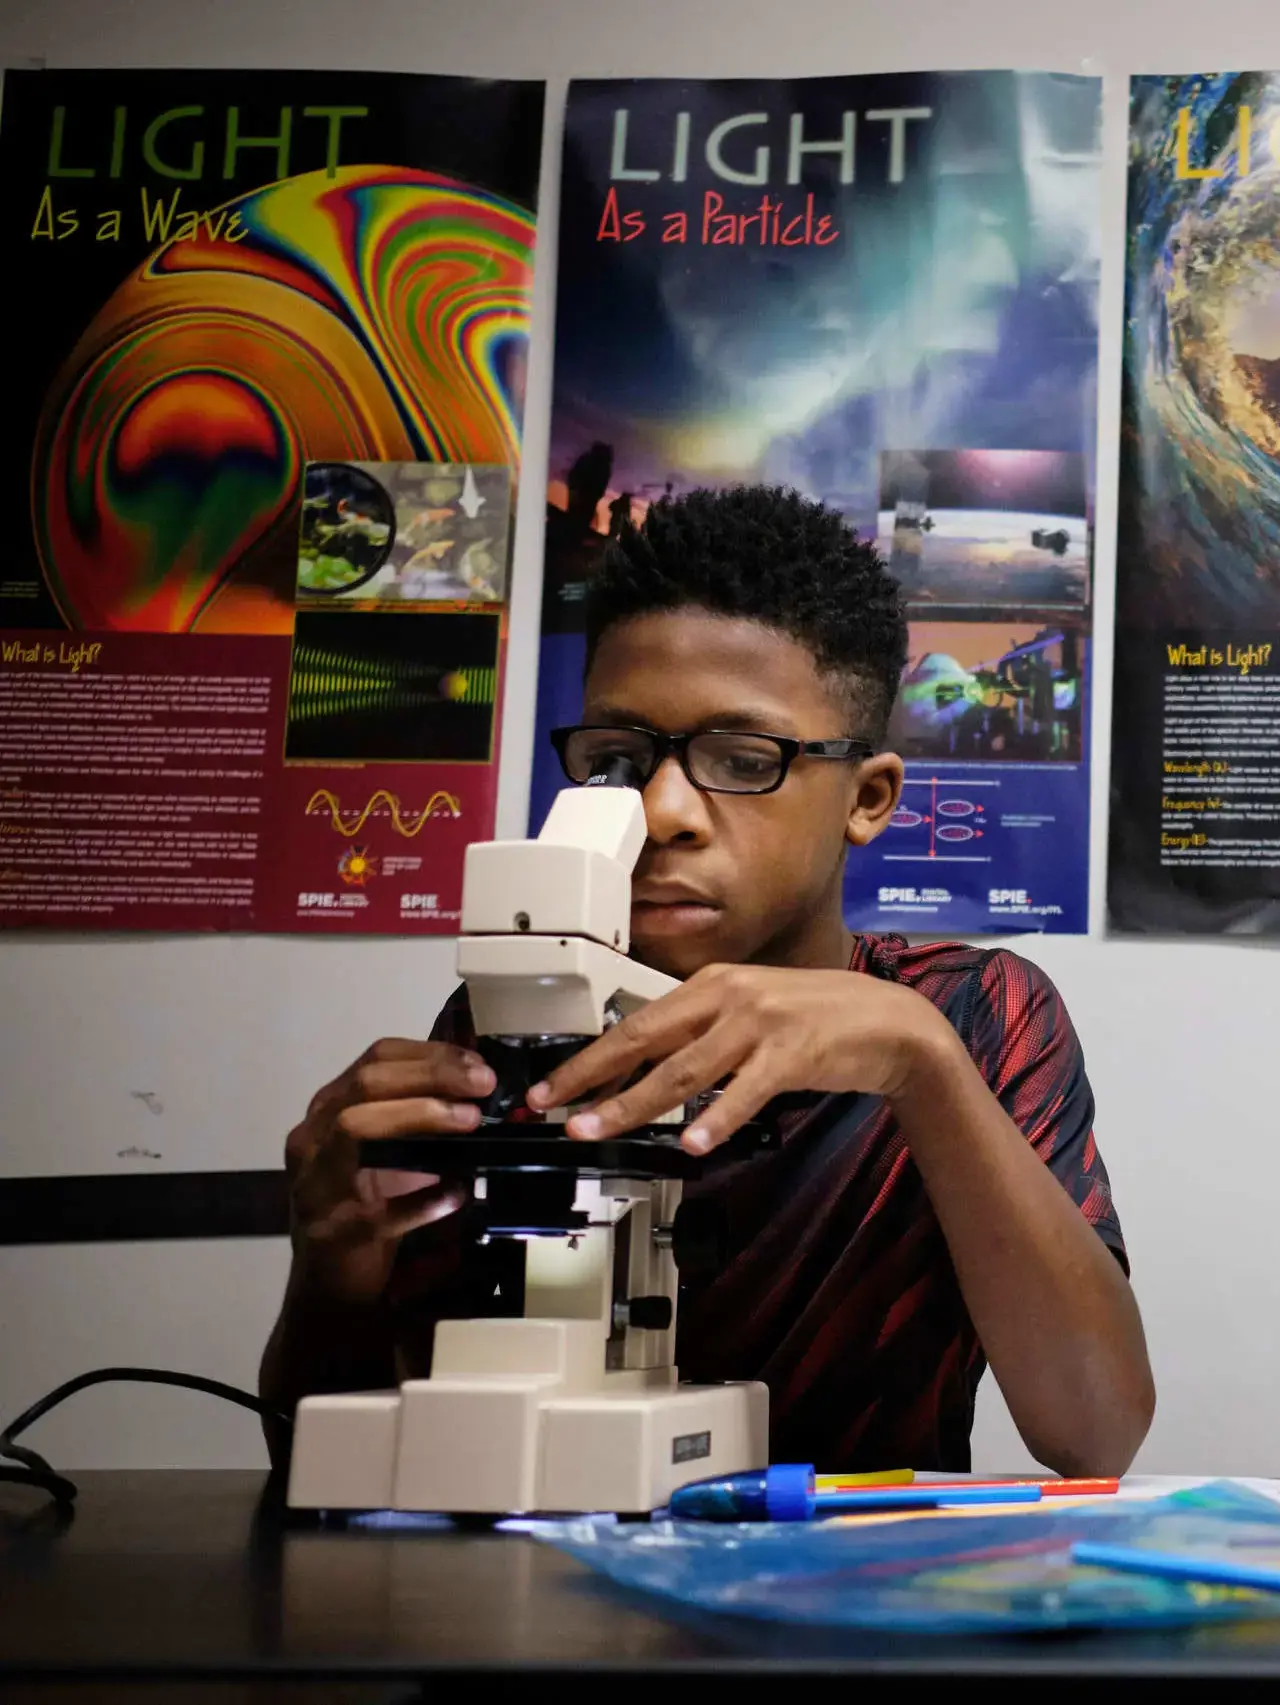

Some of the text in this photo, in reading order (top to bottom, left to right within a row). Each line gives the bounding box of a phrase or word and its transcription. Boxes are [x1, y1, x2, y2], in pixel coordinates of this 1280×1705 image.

[48, 106, 369, 180] LIGHT
[609, 107, 932, 187] LIGHT
[31, 185, 249, 243] As a Wave
[596, 187, 839, 246] As a Particle
[2, 641, 103, 672] What is Light?
[1167, 643, 1272, 675] What is Light?
